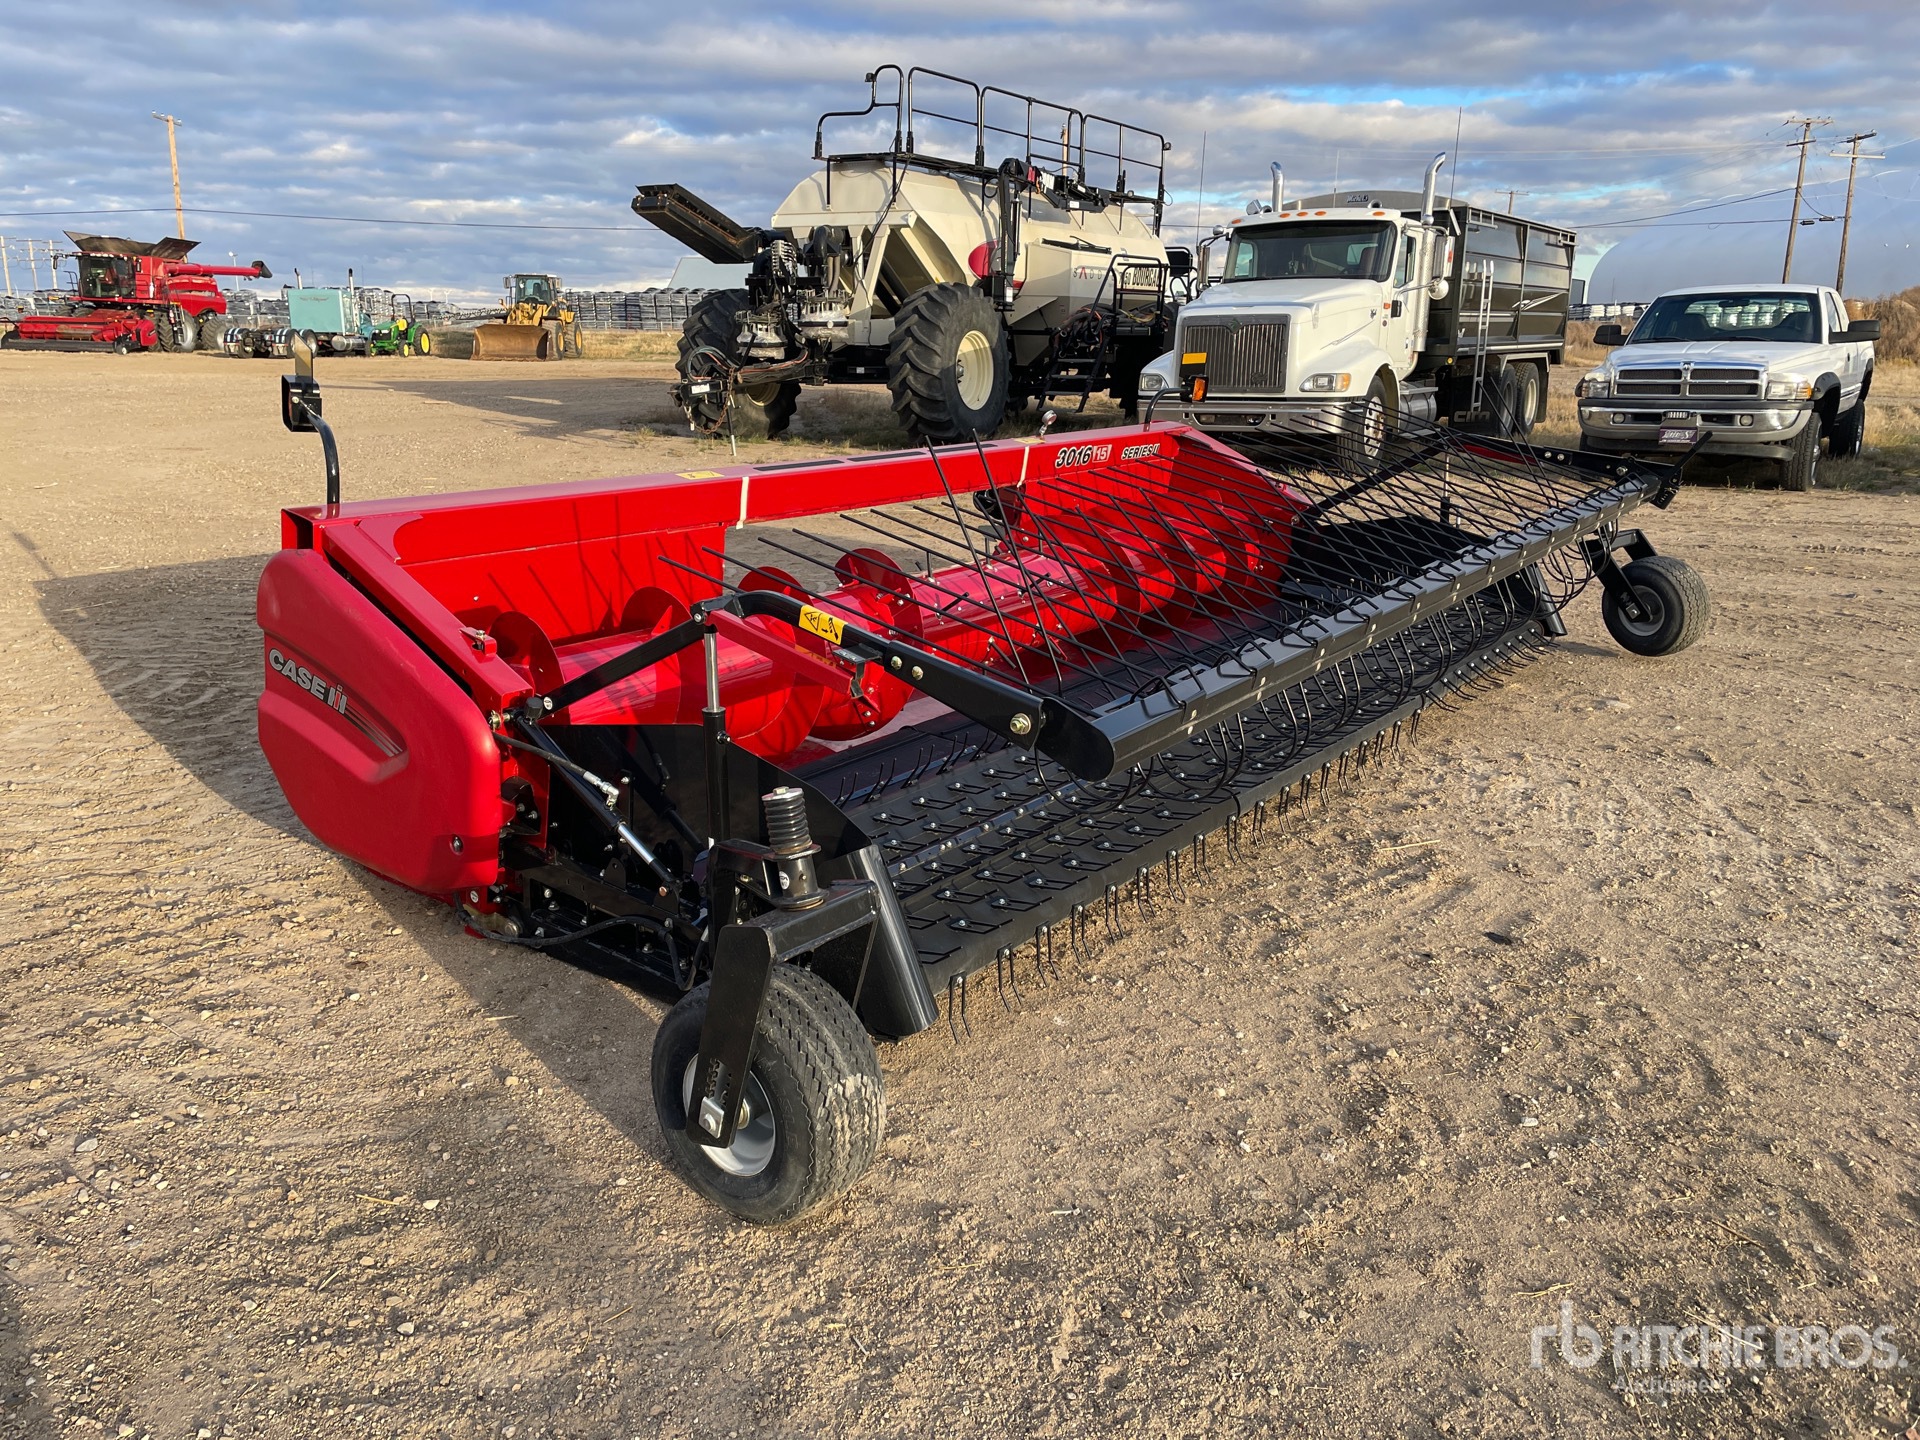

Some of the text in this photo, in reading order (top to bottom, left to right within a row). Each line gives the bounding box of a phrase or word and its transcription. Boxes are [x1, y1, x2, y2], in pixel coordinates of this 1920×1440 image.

[1055, 445, 1092, 469] 3016
[1121, 445, 1154, 460] SERIES
[269, 648, 328, 701] CASE
